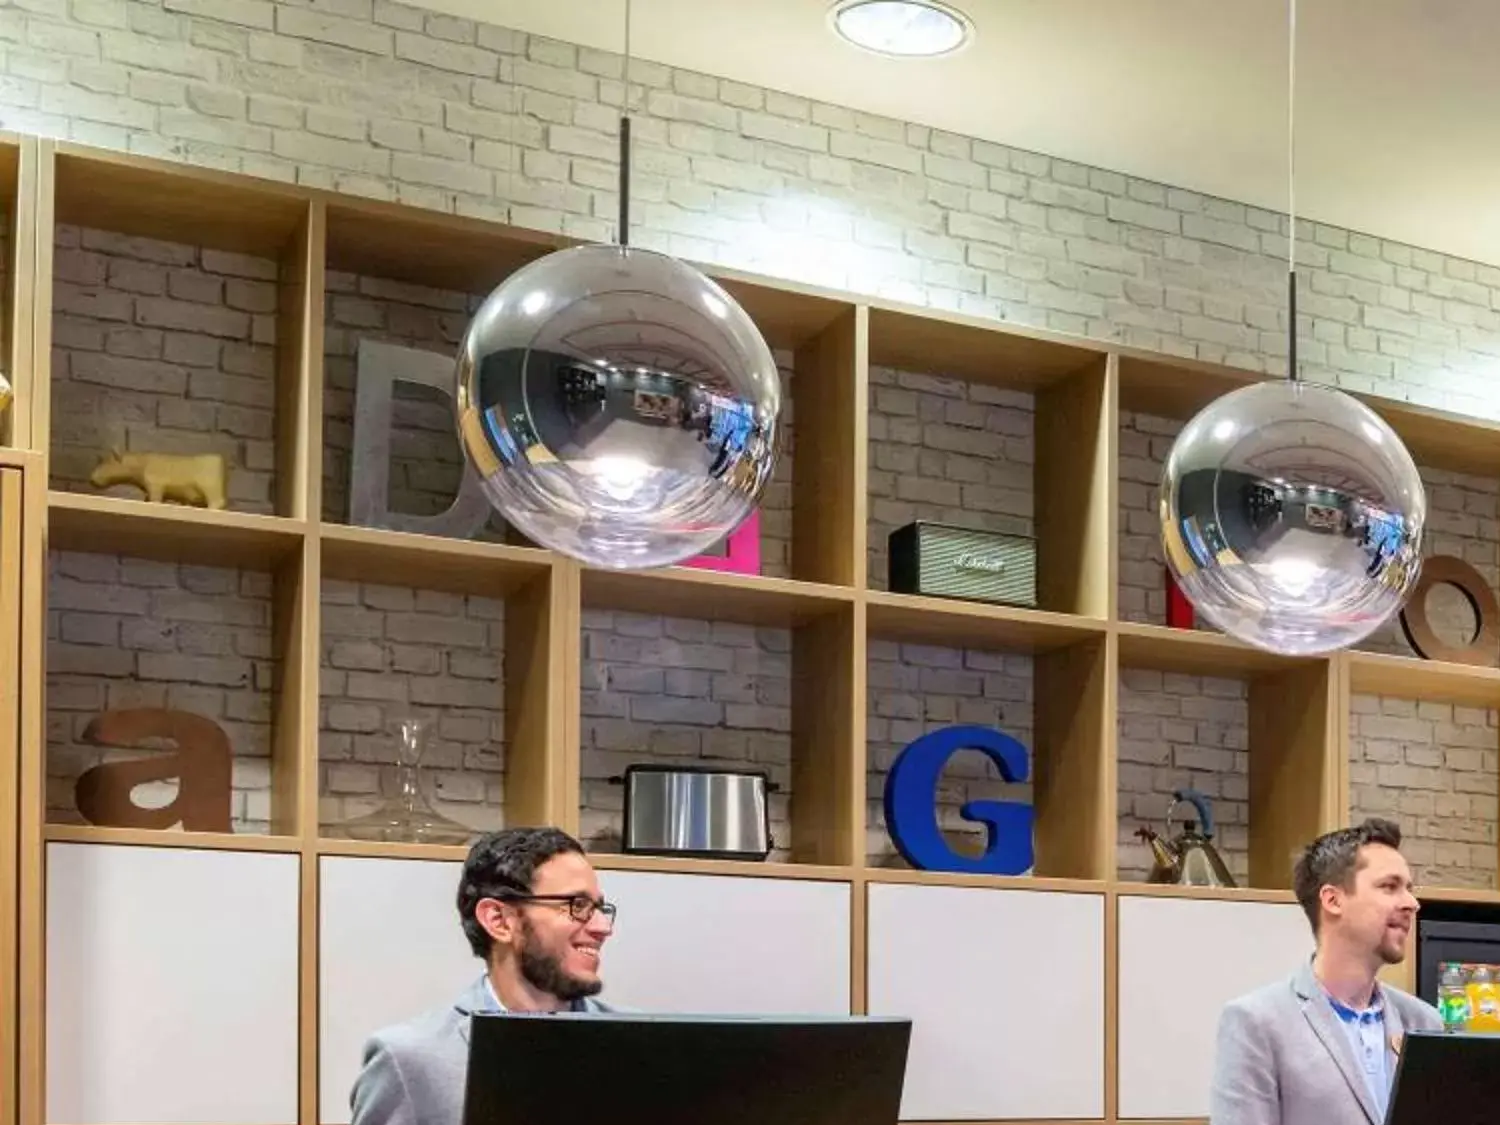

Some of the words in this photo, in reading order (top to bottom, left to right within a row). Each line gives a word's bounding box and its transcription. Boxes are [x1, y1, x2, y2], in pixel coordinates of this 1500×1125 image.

[350, 339, 494, 540] D
[75, 708, 235, 834] a
[883, 724, 1035, 876] G
